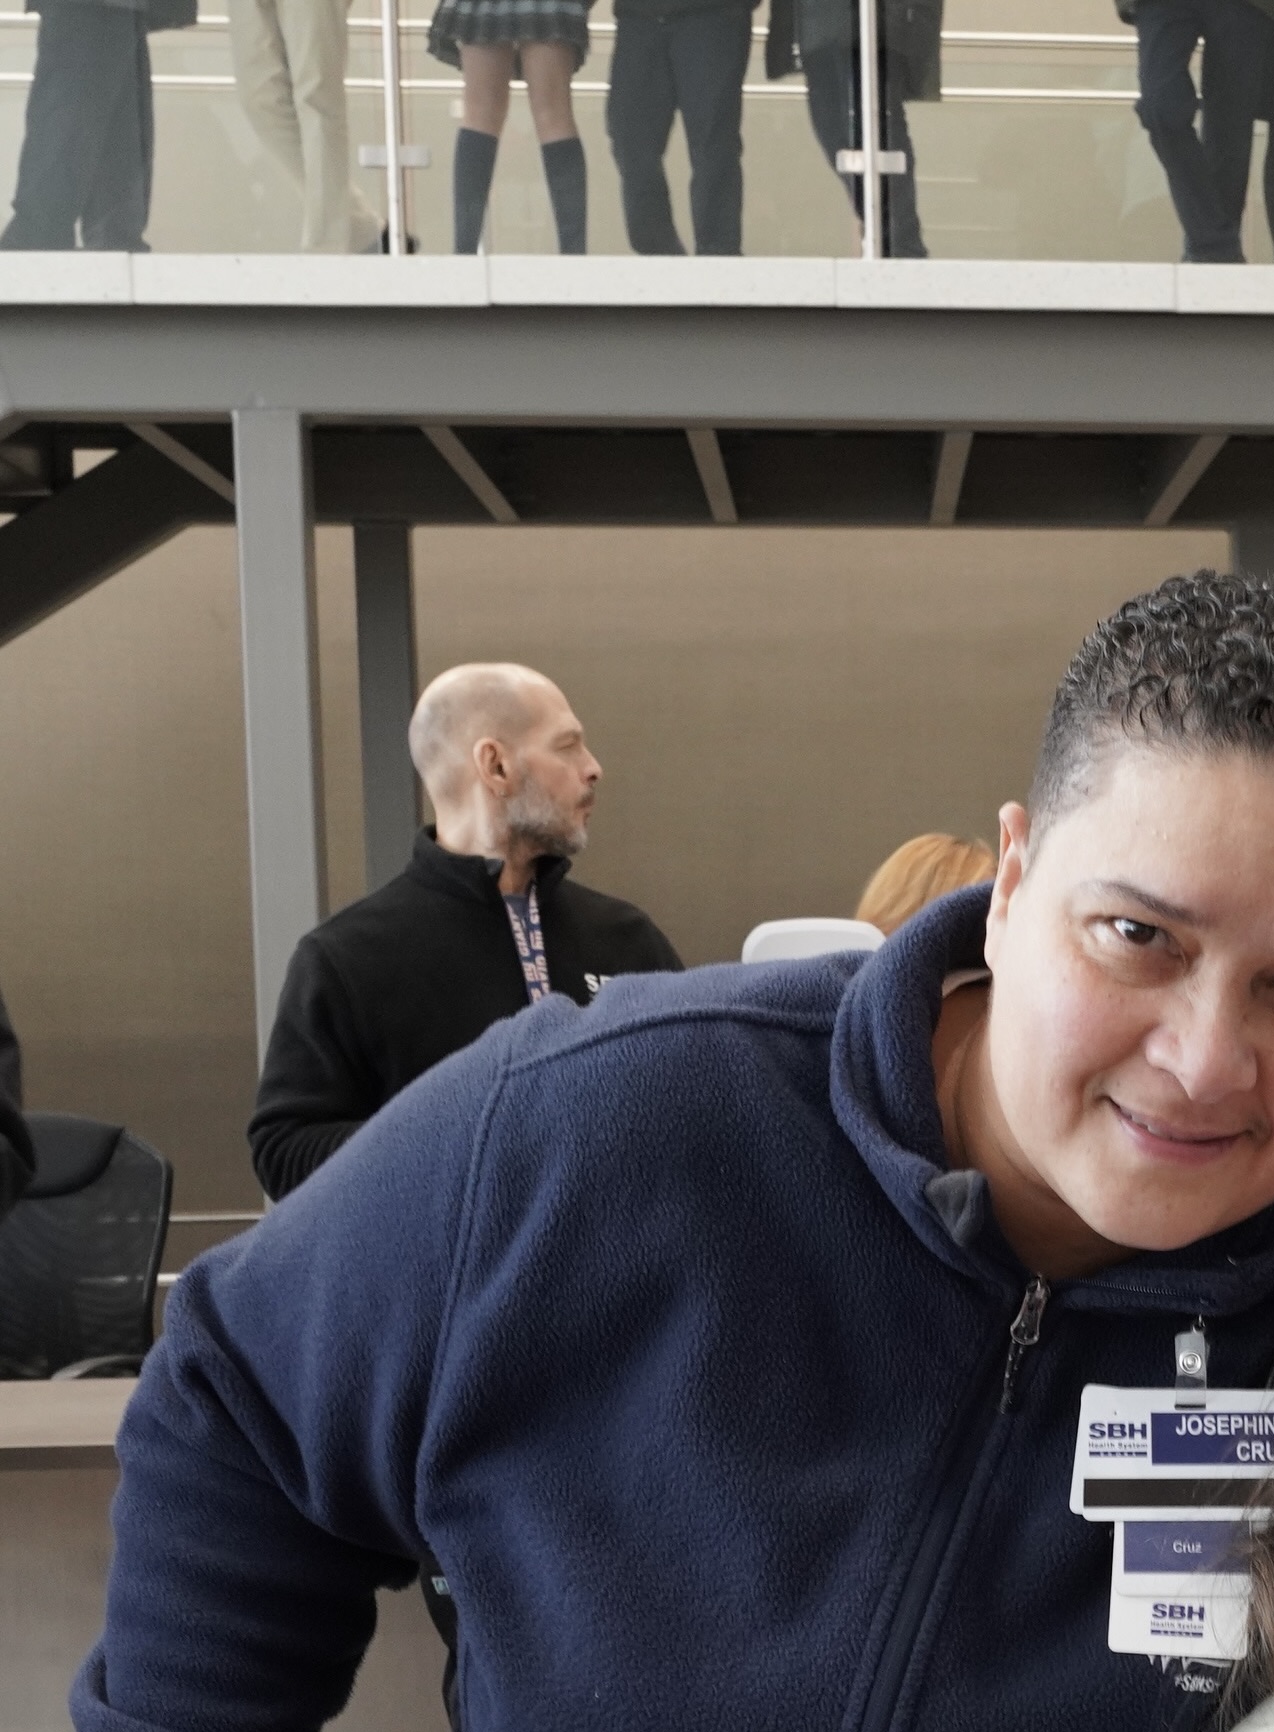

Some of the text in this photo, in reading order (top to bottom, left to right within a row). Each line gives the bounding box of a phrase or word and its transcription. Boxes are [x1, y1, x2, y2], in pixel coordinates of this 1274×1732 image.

[1089, 1423, 1147, 1440] SBH
[1173, 1539, 1203, 1554] Cruz
[1152, 1603, 1204, 1621] SBH
